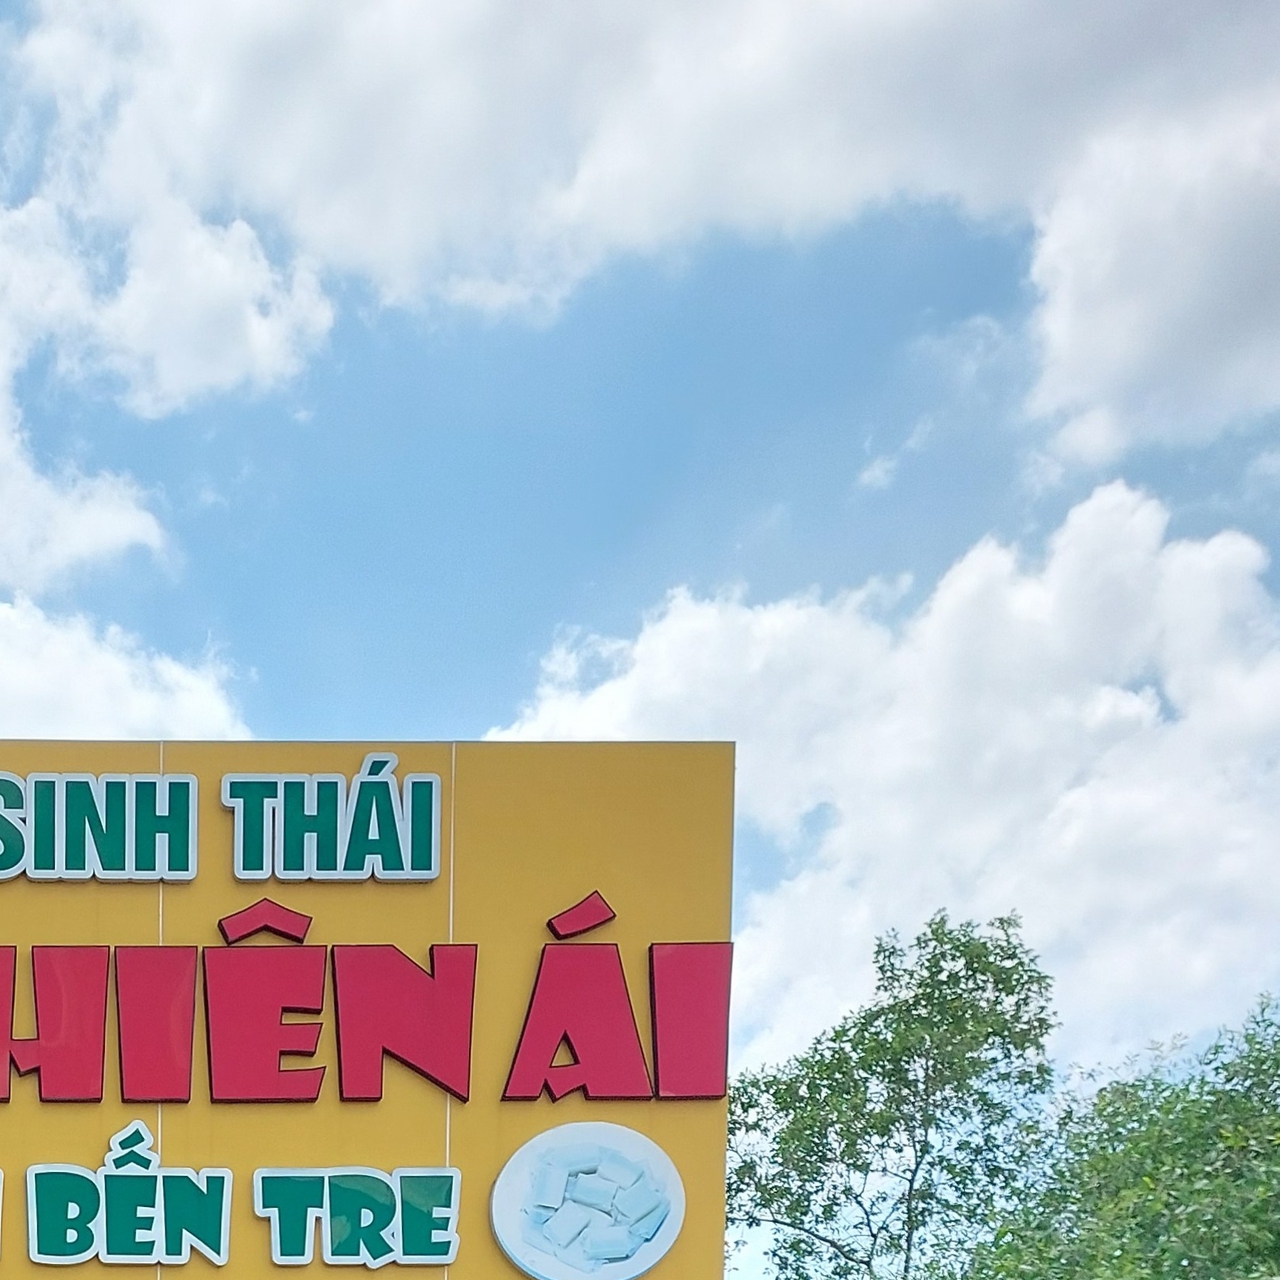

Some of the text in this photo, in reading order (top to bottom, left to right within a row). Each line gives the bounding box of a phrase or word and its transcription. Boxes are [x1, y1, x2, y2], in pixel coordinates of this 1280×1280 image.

[222, 754, 441, 880] THÁI
[501, 890, 734, 1101] ÁI
[26, 1119, 233, 1267] BẾN
[254, 1166, 461, 1270] TRE
